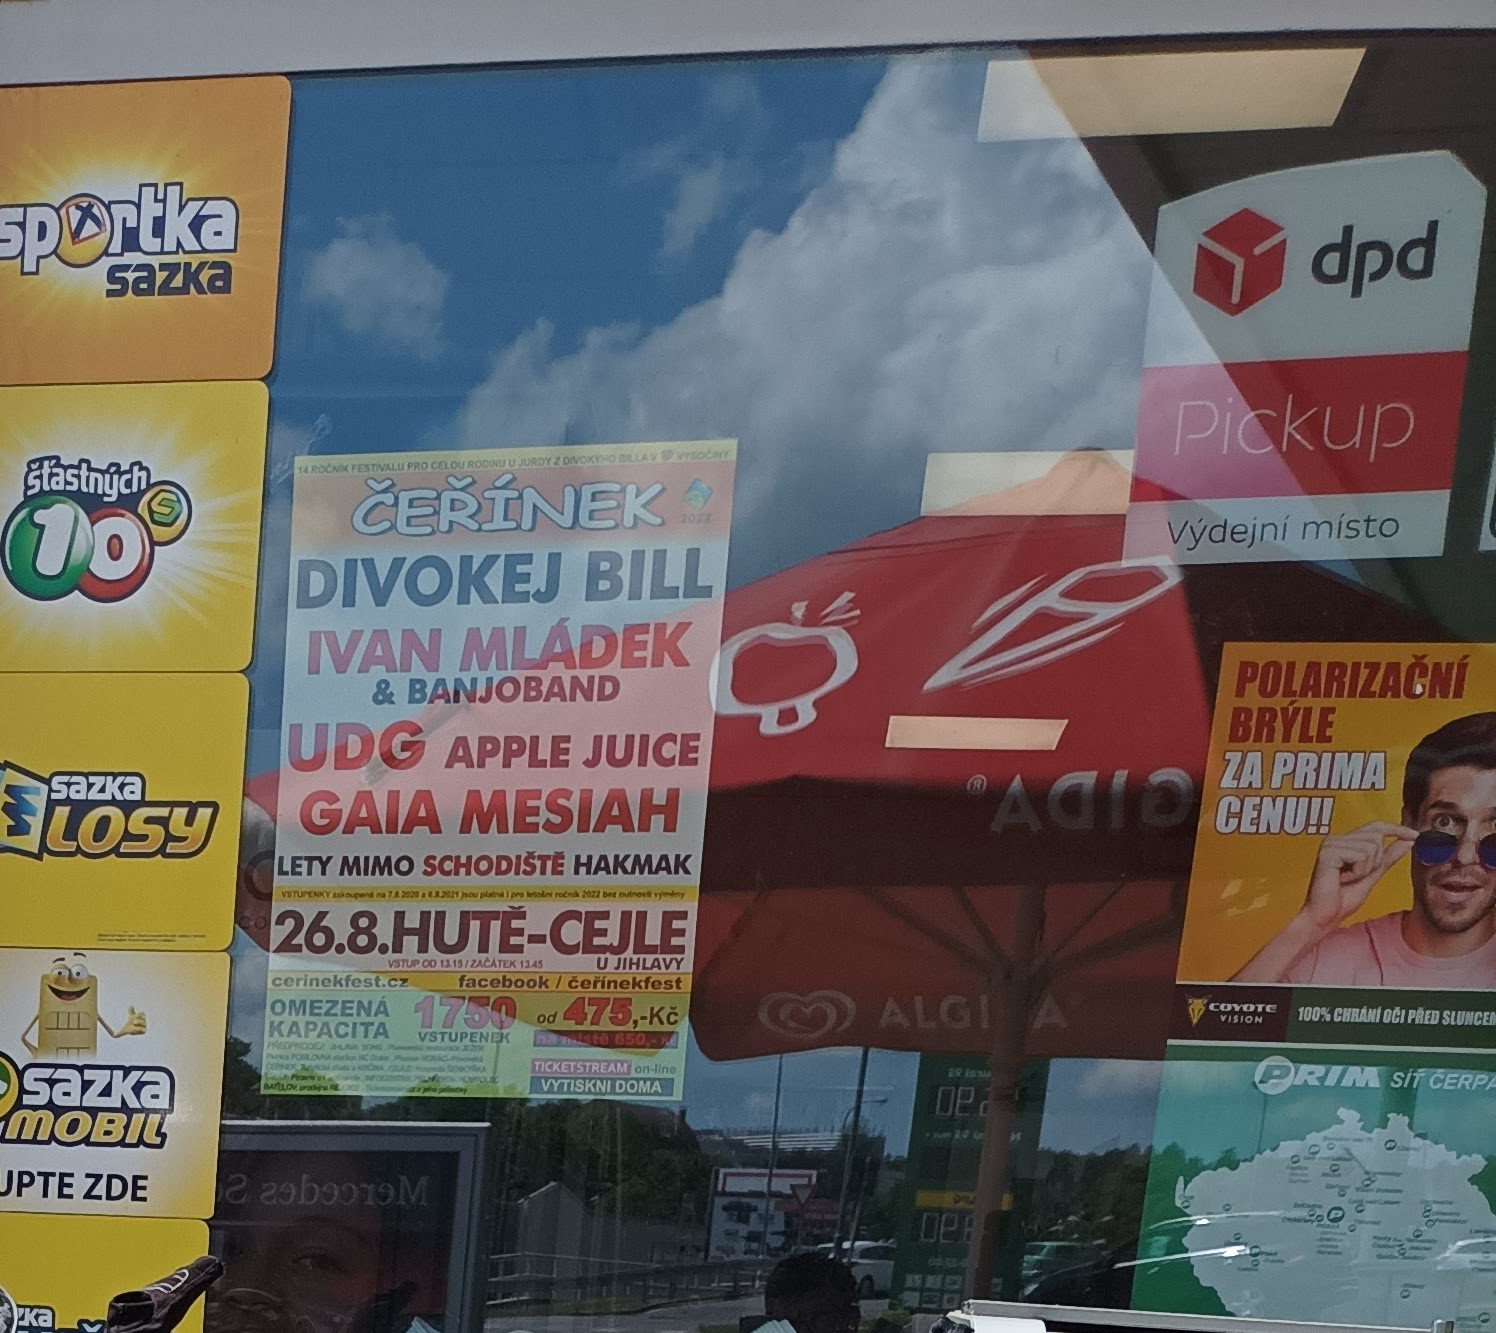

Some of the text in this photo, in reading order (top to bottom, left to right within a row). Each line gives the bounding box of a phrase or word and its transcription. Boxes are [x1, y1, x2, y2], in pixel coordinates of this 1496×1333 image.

[1311, 219, 1439, 298] dpd
[1174, 394, 1415, 463] Pickup
[24, 455, 152, 500] šťastných
[351, 462, 404, 473] FESTIVALU
[407, 460, 429, 470] PRO
[430, 459, 465, 470] CELOU
[468, 458, 505, 469] RODINU
[352, 471, 665, 537] ČEŘÍNEK
[16, 500, 149, 590] 10
[1167, 512, 1401, 551] Výdejní místo
[295, 547, 713, 610] DIVOKEJ BILL
[307, 617, 693, 676] IVAN MLÁDEK
[371, 675, 621, 706] & BANJOBAND
[1233, 653, 1472, 699] POLARIZAČNÍ
[1227, 700, 1336, 744] BRÝLE
[288, 720, 701, 772] UDG APPLE JUICE
[50, 774, 143, 801] sazka
[1219, 750, 1387, 791] ZA PRIMA
[45, 803, 217, 855] LOSY
[299, 787, 680, 837] GAIA MESIAH
[1214, 795, 1335, 836] CENU!!
[277, 850, 692, 877] LETY MIMO SCHODIŠTĚ HAKMAK
[388, 960, 419, 970] VSTUP
[422, 960, 437, 970] OD
[596, 956, 685, 971] U JIHLAVY
[458, 973, 550, 990] facebook
[567, 973, 683, 991] čeřínekfest
[269, 996, 390, 1019] OMEZENÁ
[413, 995, 517, 1030] 1750
[536, 1009, 557, 1026] od
[879, 994, 1069, 1031] ALGIA
[1209, 1001, 1278, 1013] COYOTE
[1220, 1014, 1263, 1024] VISION
[1297, 1006, 1331, 1022] 100%
[1333, 1005, 1381, 1023] CHRÁNÍ
[1383, 1005, 1406, 1024] OČI
[1408, 1006, 1439, 1025] PŘED
[268, 1020, 390, 1041] KAPACITA
[418, 1031, 510, 1044] VSTUPENEK
[533, 1060, 628, 1074] TICKETSTREAM
[1256, 1058, 1381, 1092] PRIM
[22, 1068, 172, 1110] sazka
[540, 1078, 662, 1094] VYTISKNI DOMA
[83, 1172, 149, 1203] ZDE
